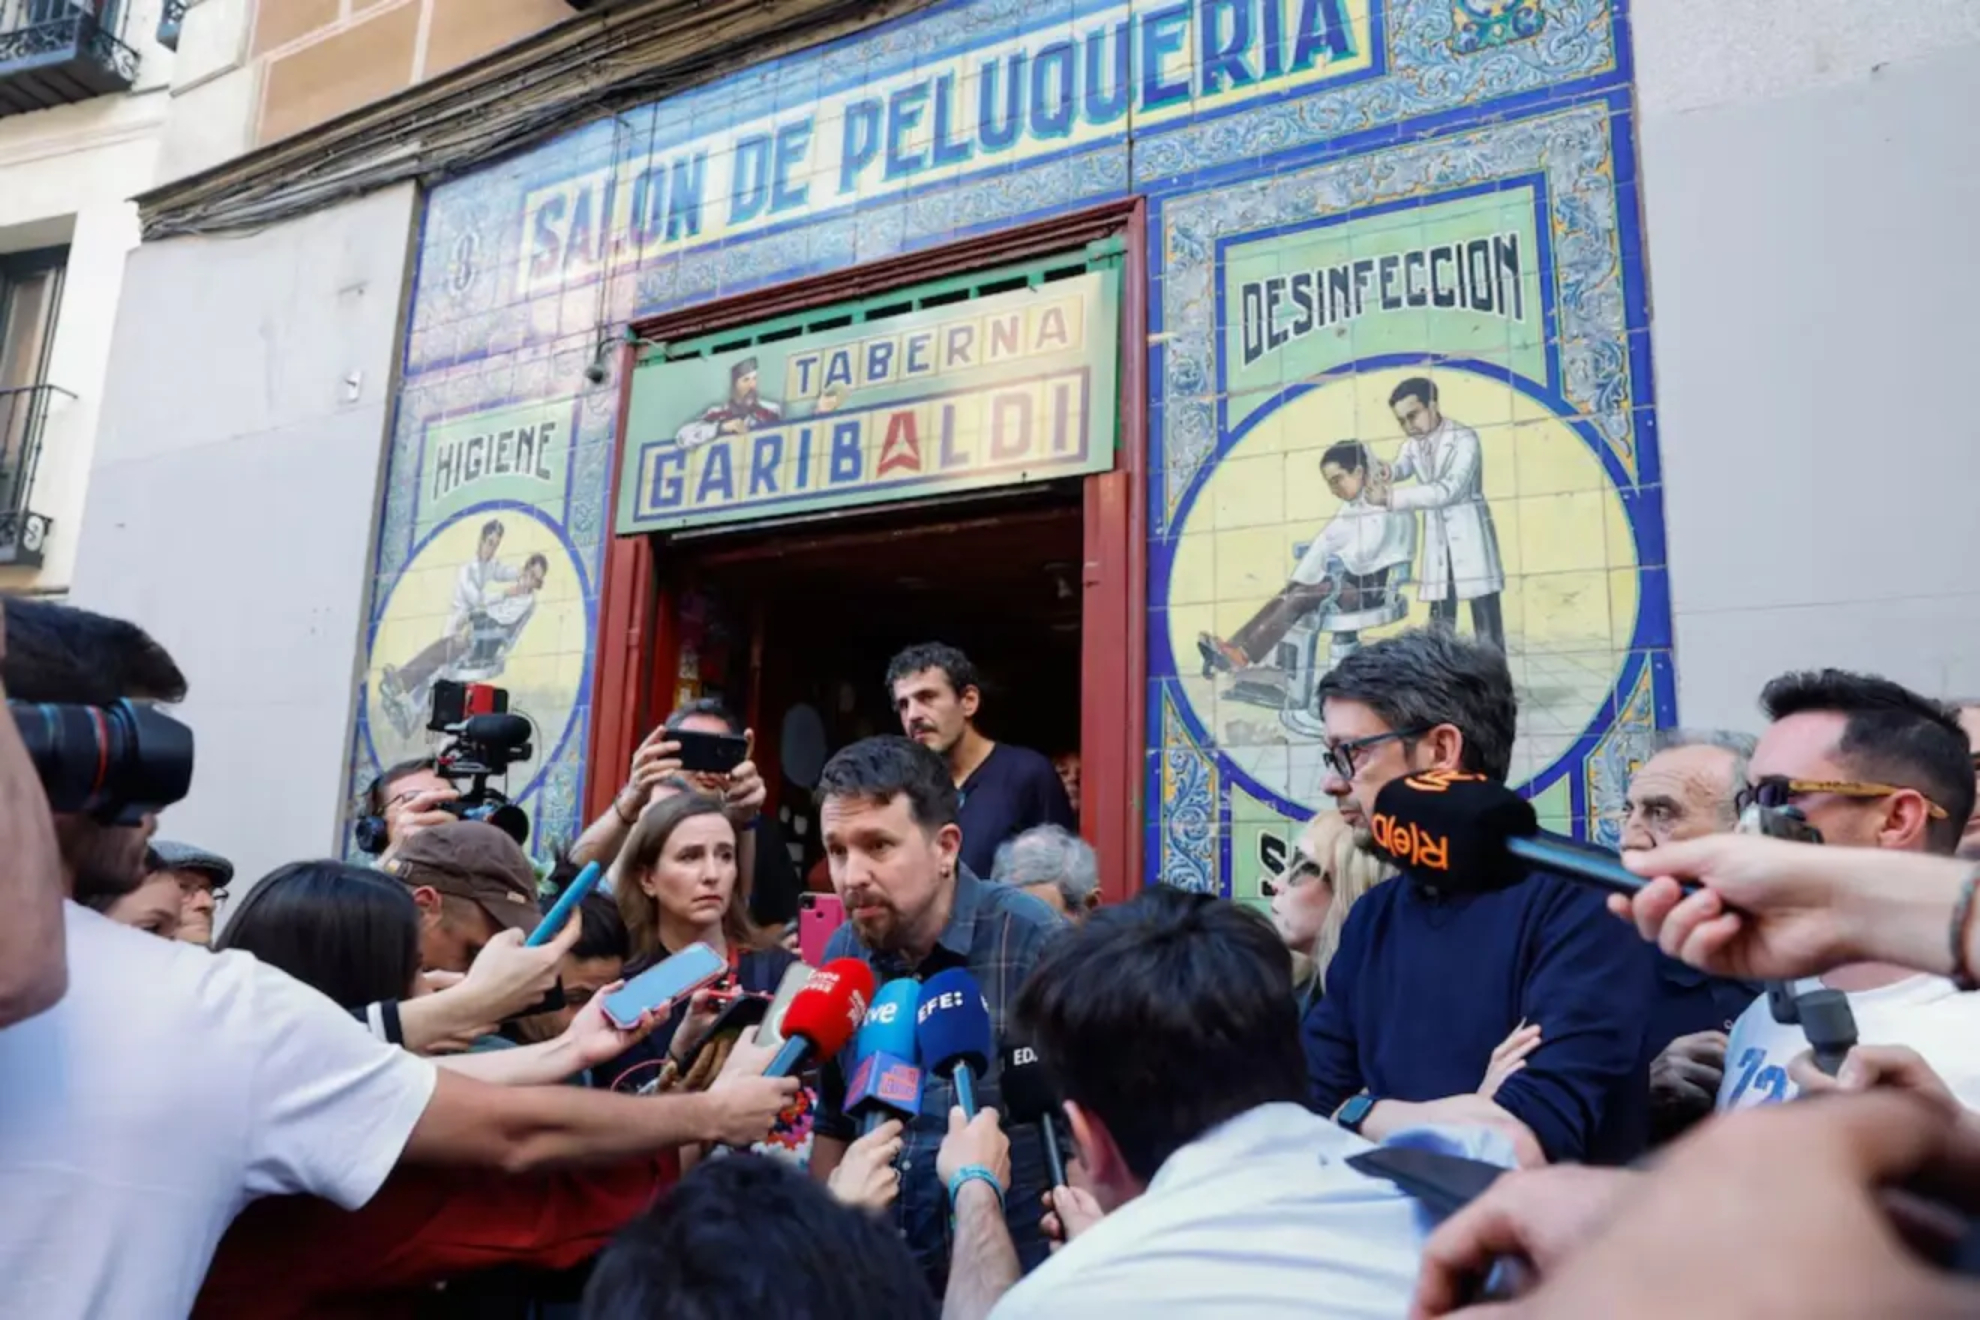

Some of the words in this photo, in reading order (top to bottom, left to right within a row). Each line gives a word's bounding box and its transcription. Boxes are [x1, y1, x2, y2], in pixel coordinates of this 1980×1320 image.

[529, 147, 709, 277] SALON
[727, 113, 816, 227] DE
[838, 0, 1360, 195] PELUQUERIA
[795, 306, 1069, 395] TABERNA
[1243, 233, 1523, 366] DESINFECCION
[433, 421, 556, 500] HIGIENE
[649, 384, 1070, 509] GARIBALDI
